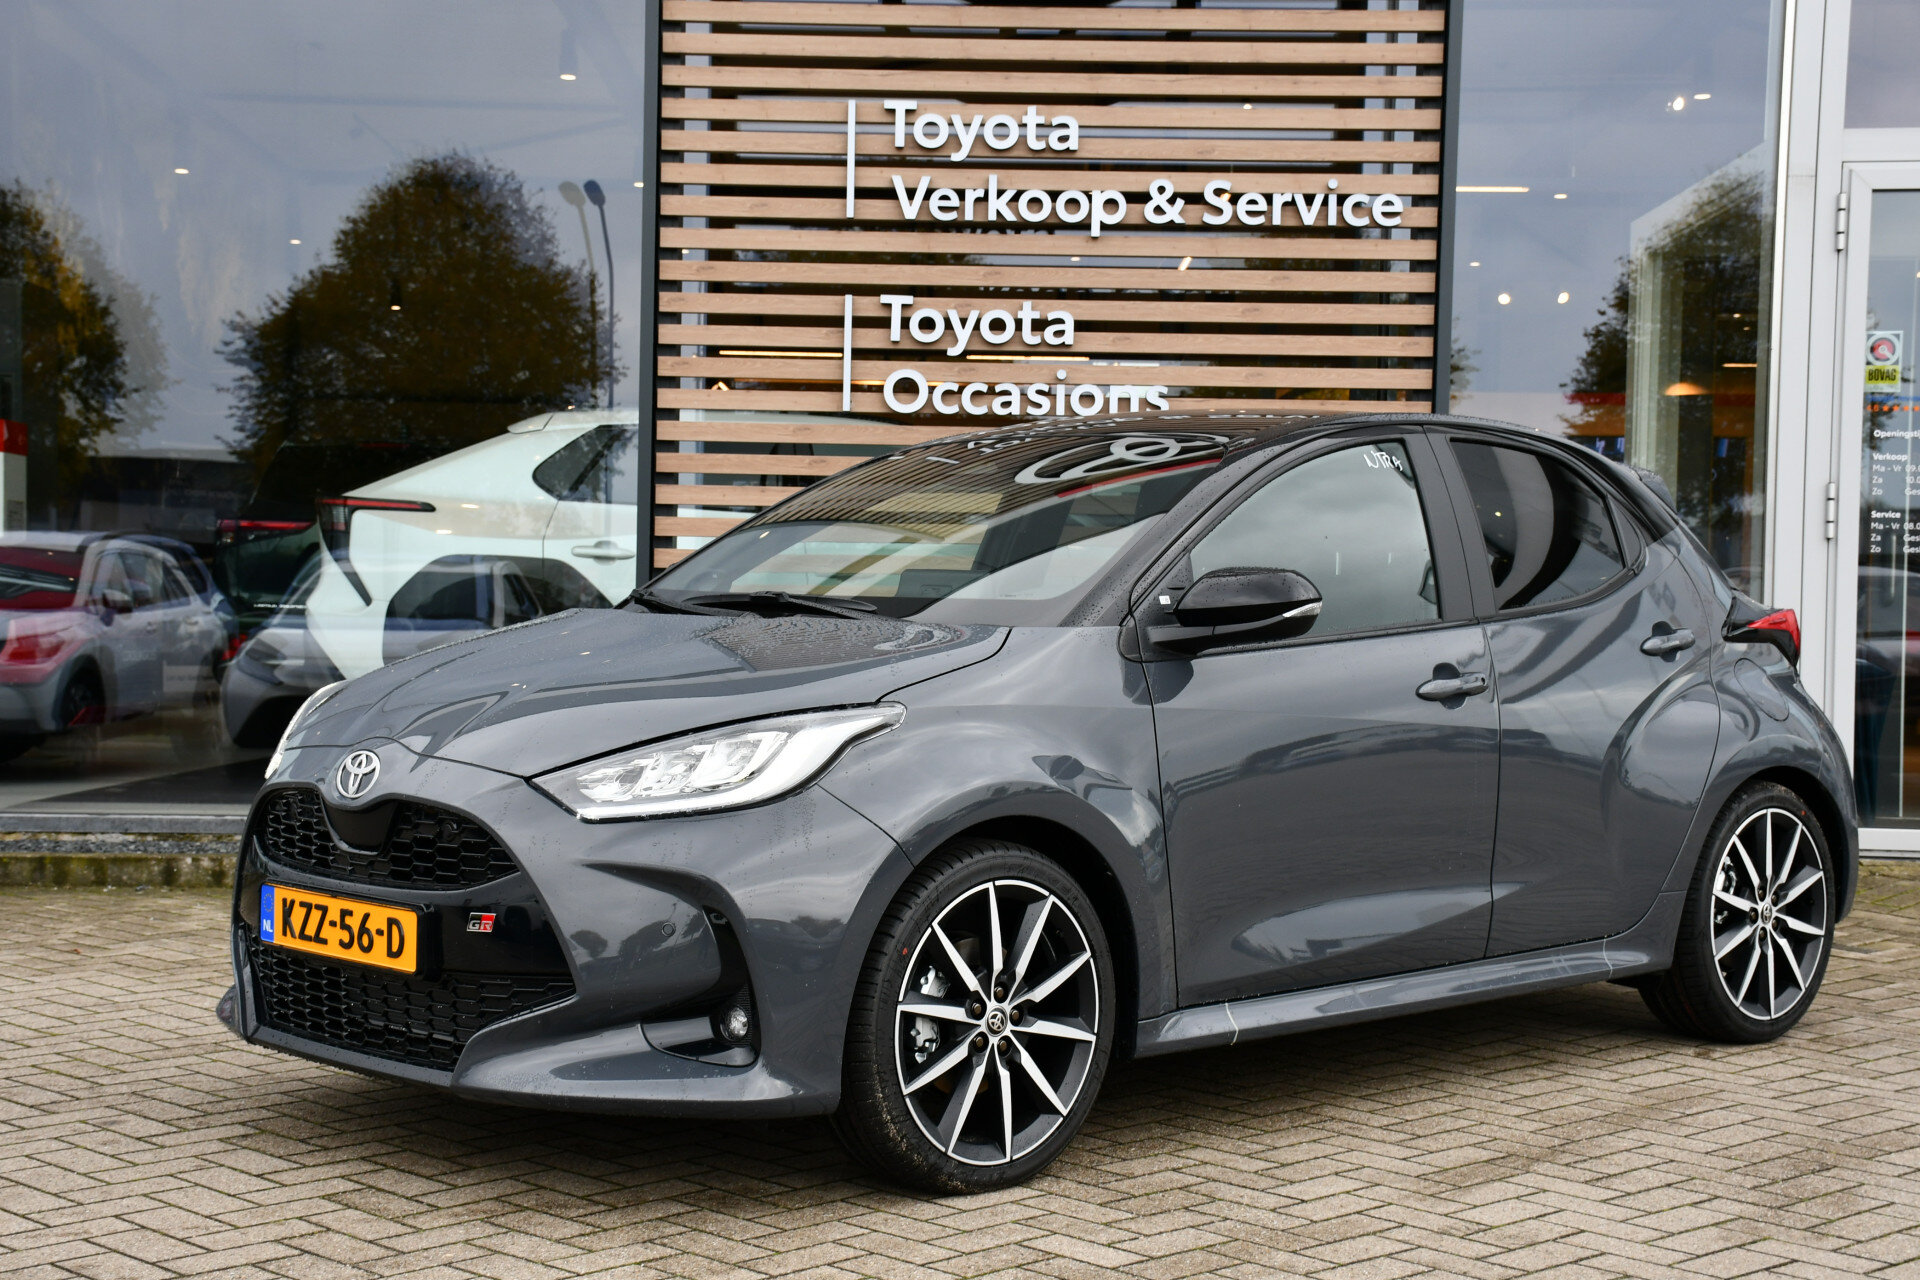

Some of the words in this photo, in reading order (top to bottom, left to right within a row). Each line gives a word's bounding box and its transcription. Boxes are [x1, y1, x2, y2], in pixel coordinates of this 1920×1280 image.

[883, 99, 1080, 162] Toyota
[891, 174, 1127, 237] Verkoop
[1143, 178, 1186, 225] &
[1202, 178, 1405, 228] Service
[879, 294, 1076, 356] Toyota
[1868, 368, 1897, 382] BOVAG
[883, 368, 1170, 417] Occasions
[1872, 453, 1908, 462] Verkoop
[1872, 464, 1885, 472] Ma
[1893, 464, 1902, 472] Vr
[1872, 475, 1883, 484] Za
[1872, 487, 1883, 495] Zo
[1870, 510, 1901, 518] Service
[1870, 521, 1884, 530] Ma
[1891, 522, 1900, 530] Vr
[1870, 533, 1881, 541] Za
[1870, 544, 1881, 553] Zo
[262, 918, 274, 934] NL
[281, 897, 406, 960] KZZ-56-D
[468, 918, 493, 931] GR
